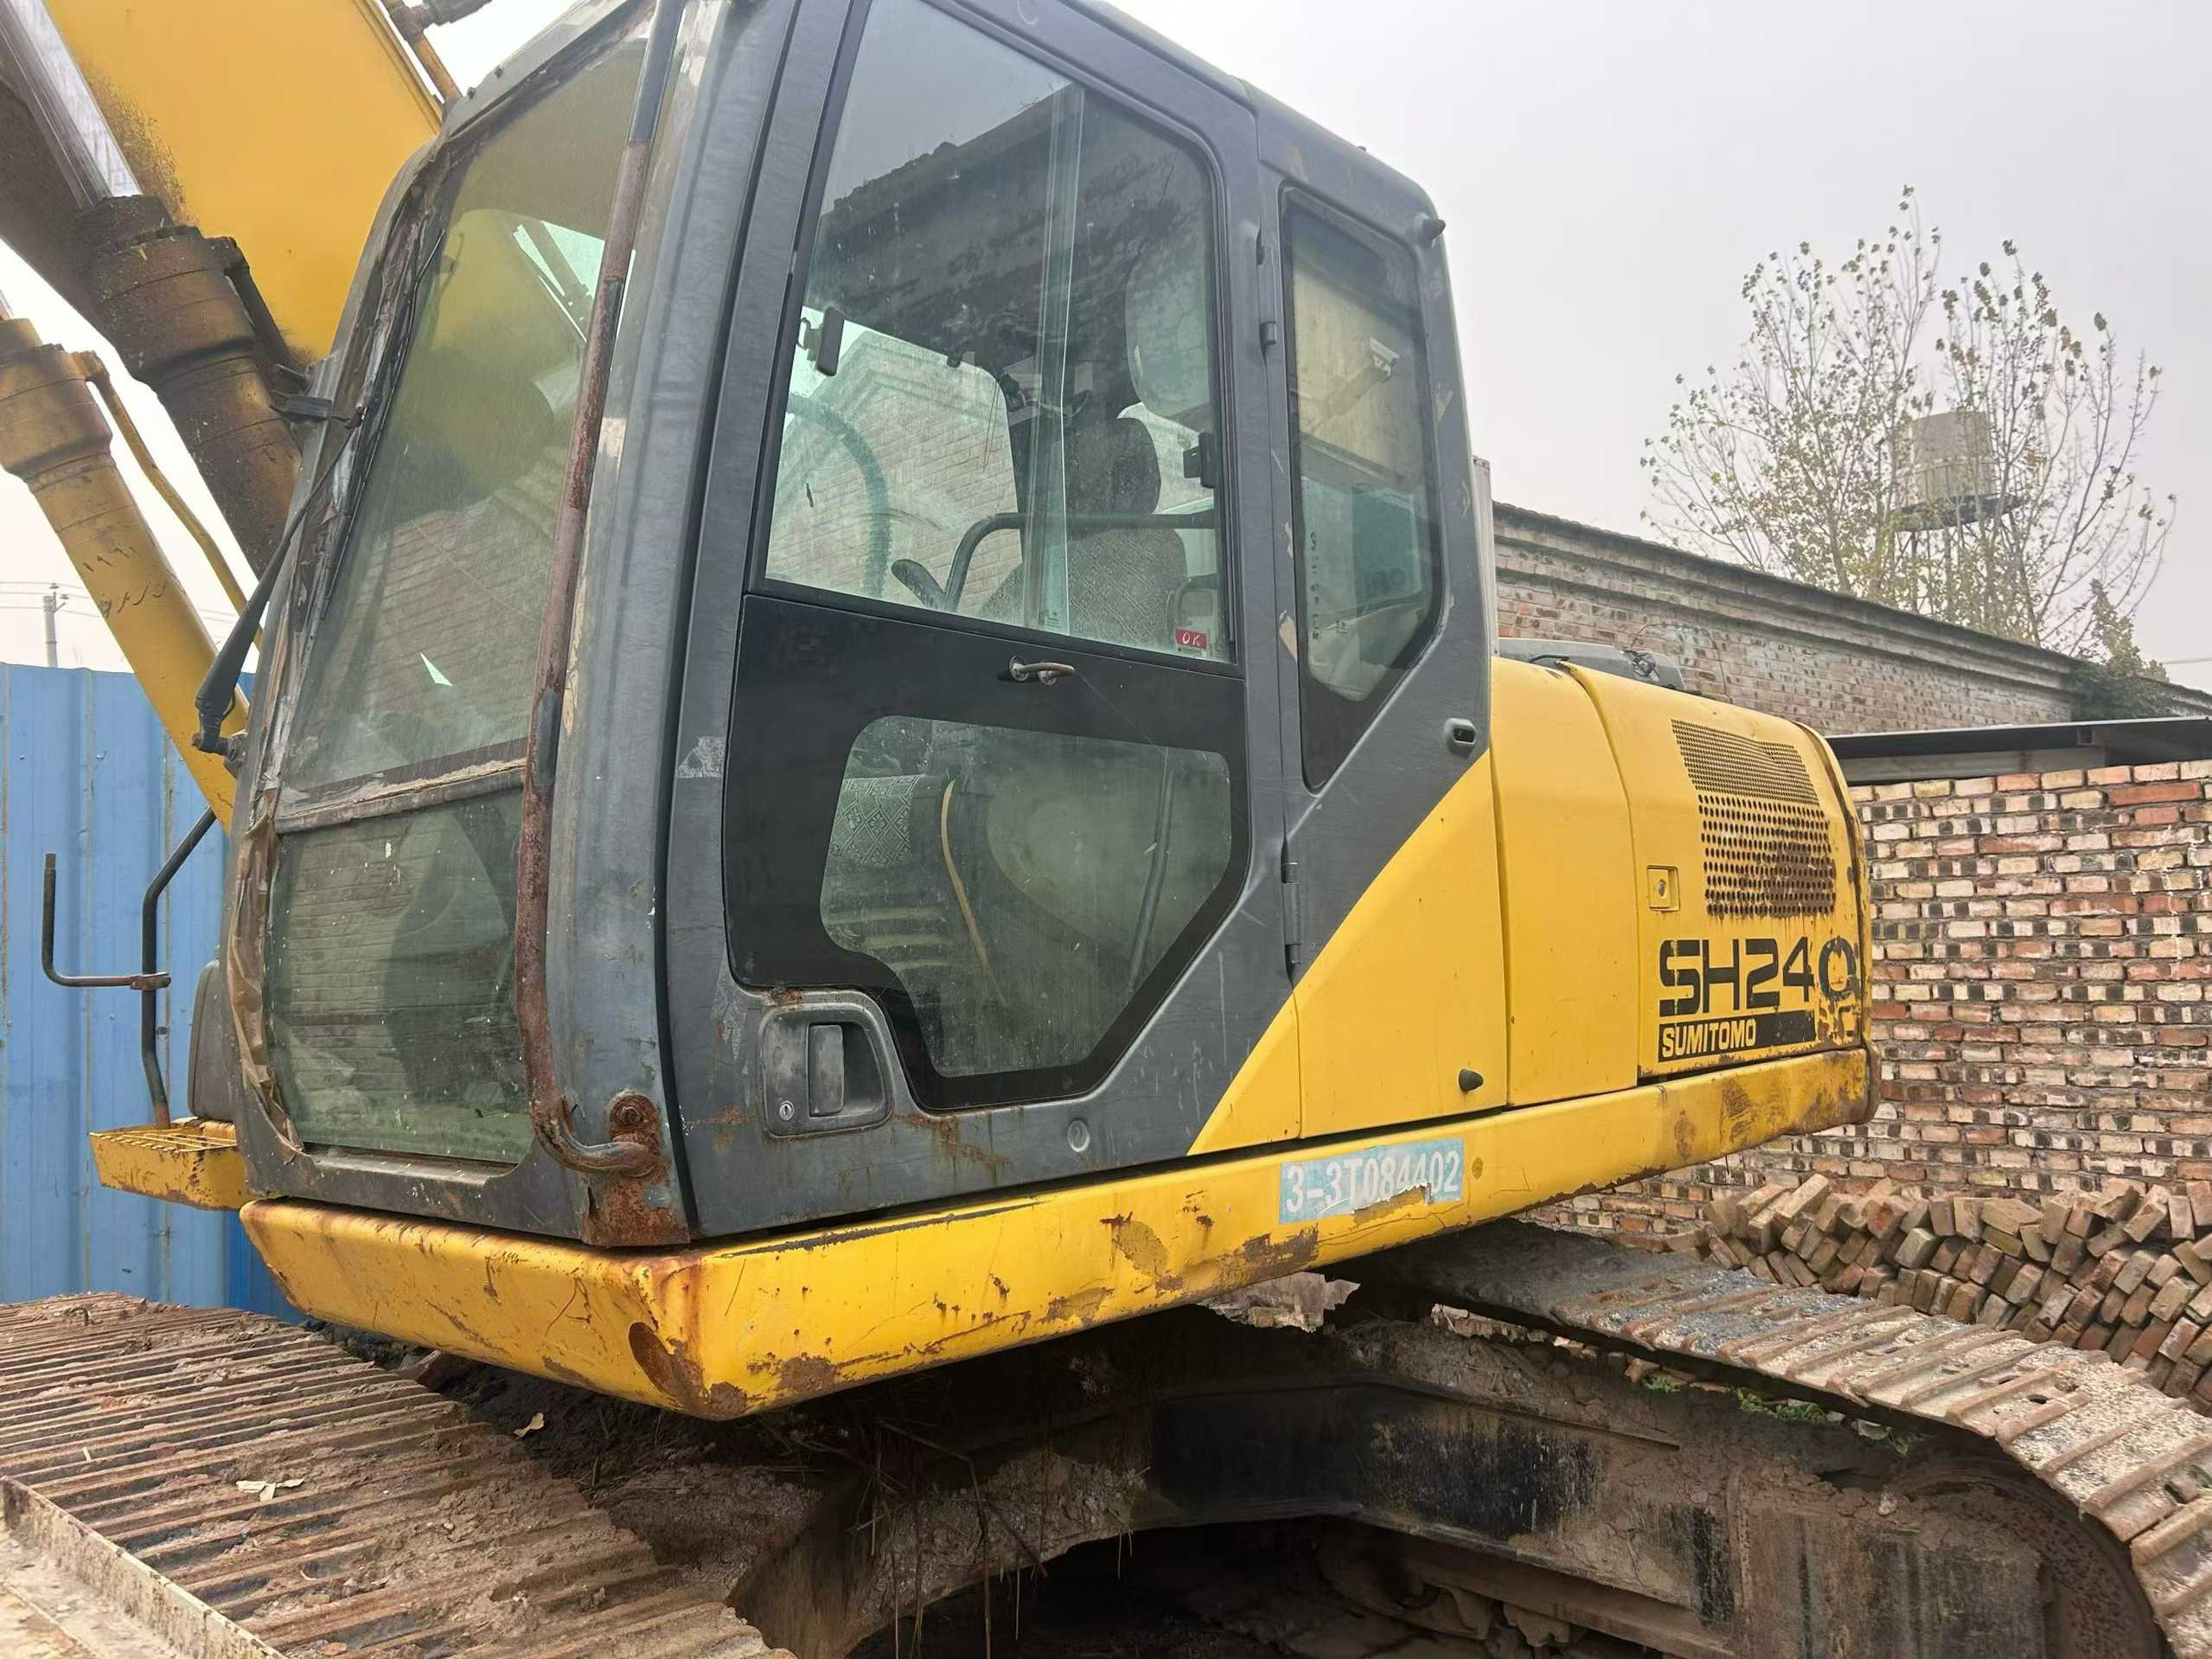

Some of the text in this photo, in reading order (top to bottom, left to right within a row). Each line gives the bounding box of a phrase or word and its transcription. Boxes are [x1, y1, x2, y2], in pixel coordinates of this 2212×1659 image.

[1182, 631, 1201, 646] OK
[1659, 936, 1857, 1017] SH240
[1661, 1018, 1757, 1058] SUMITOMO
[1286, 1150, 1460, 1213] 3-3T084402
